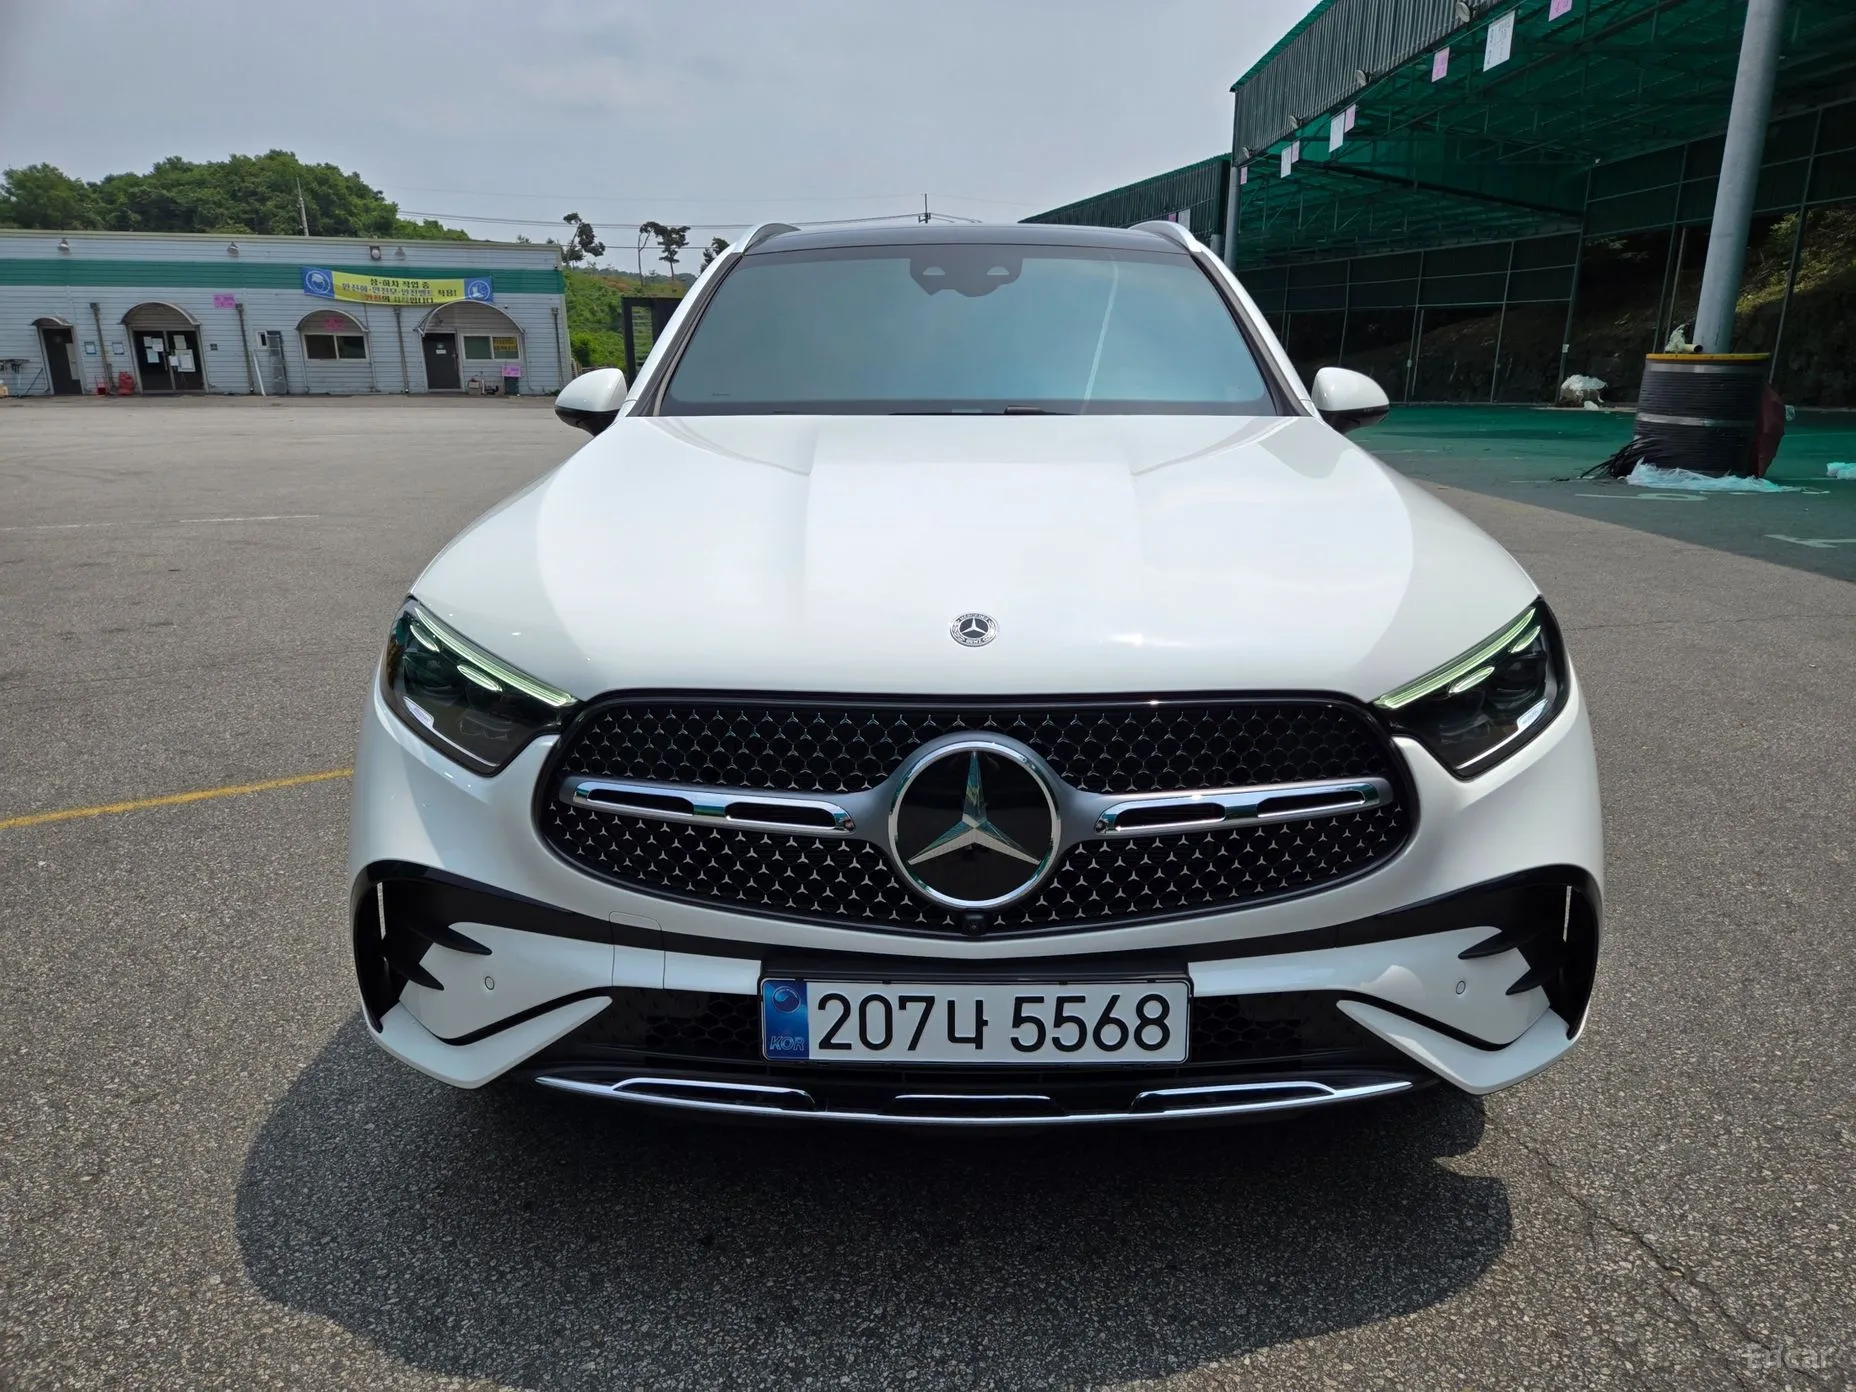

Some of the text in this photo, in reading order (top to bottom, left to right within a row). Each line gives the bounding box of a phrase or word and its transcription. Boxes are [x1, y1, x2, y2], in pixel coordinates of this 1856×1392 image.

[402, 279, 419, 289] 작업
[422, 281, 430, 289] 중
[817, 992, 1172, 1053] 207나 5568
[769, 1035, 805, 1051] KOR
